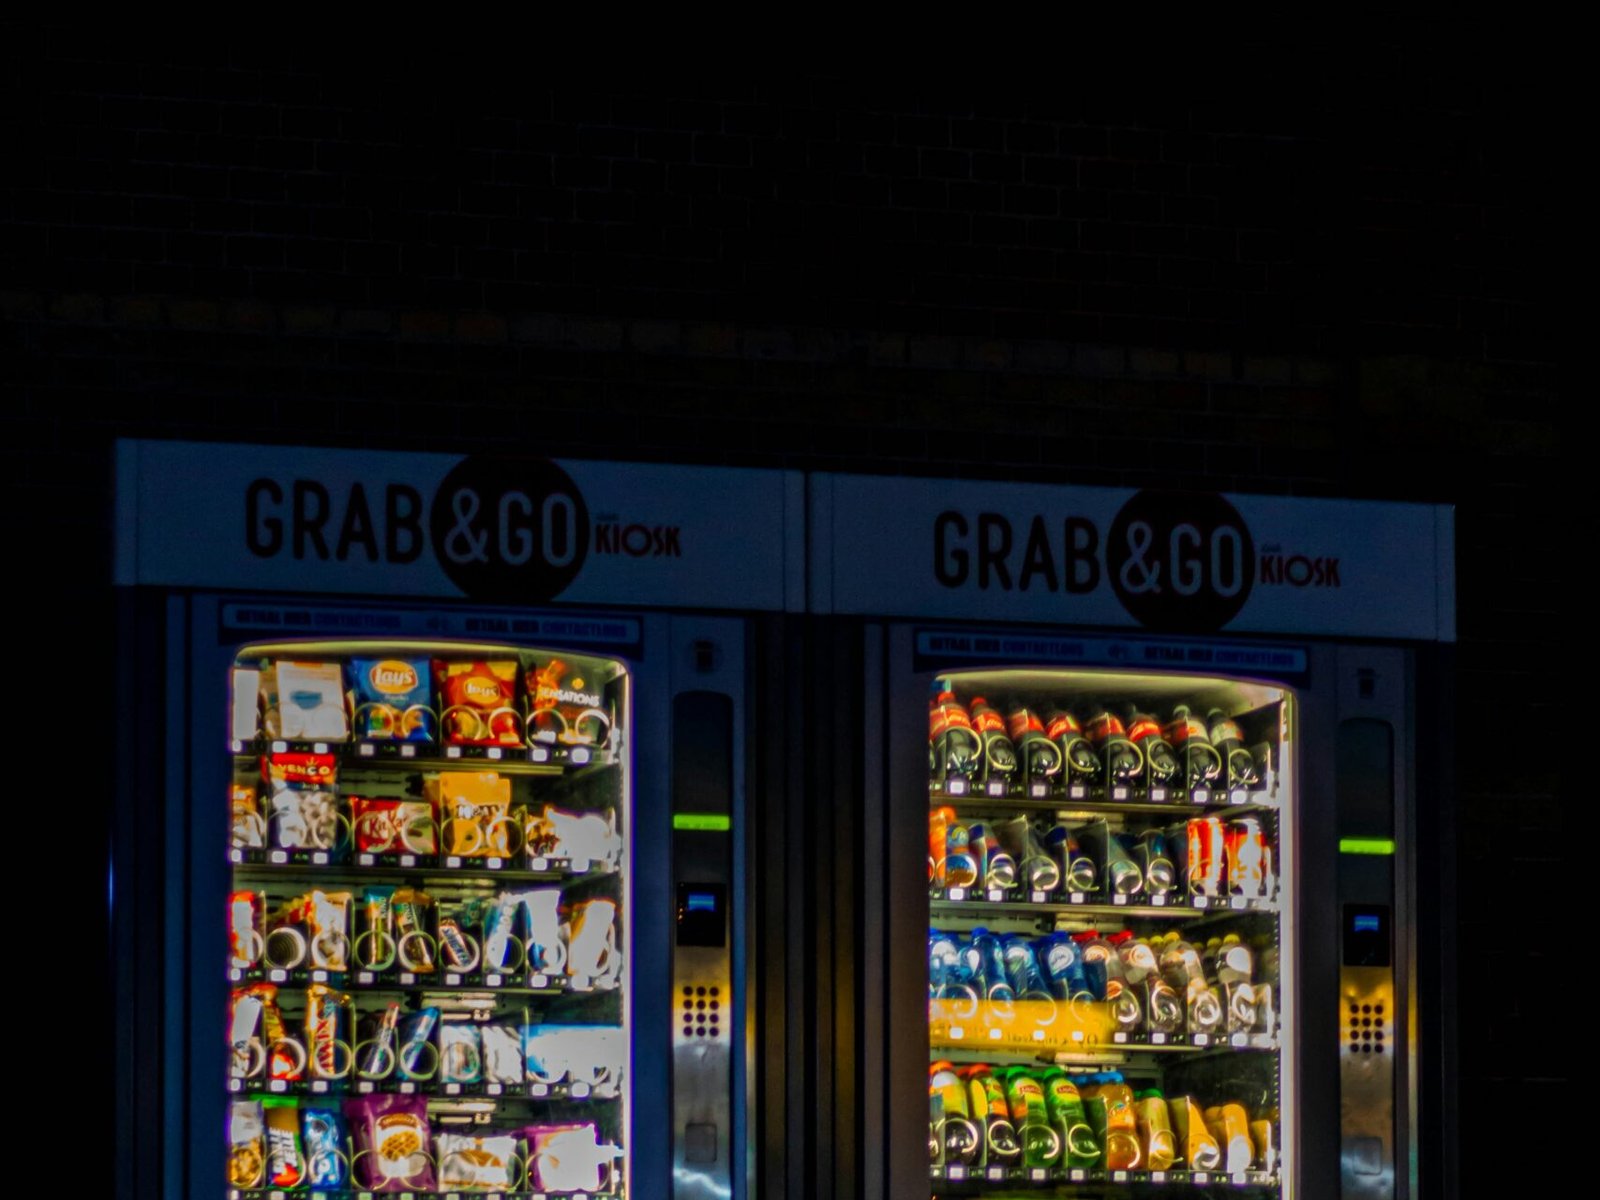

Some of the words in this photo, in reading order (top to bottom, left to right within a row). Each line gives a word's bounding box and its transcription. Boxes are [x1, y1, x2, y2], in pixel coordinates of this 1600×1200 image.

[595, 523, 682, 558] KIOSK
[1260, 555, 1342, 588] KIOSK
[277, 762, 331, 777] VENCO
